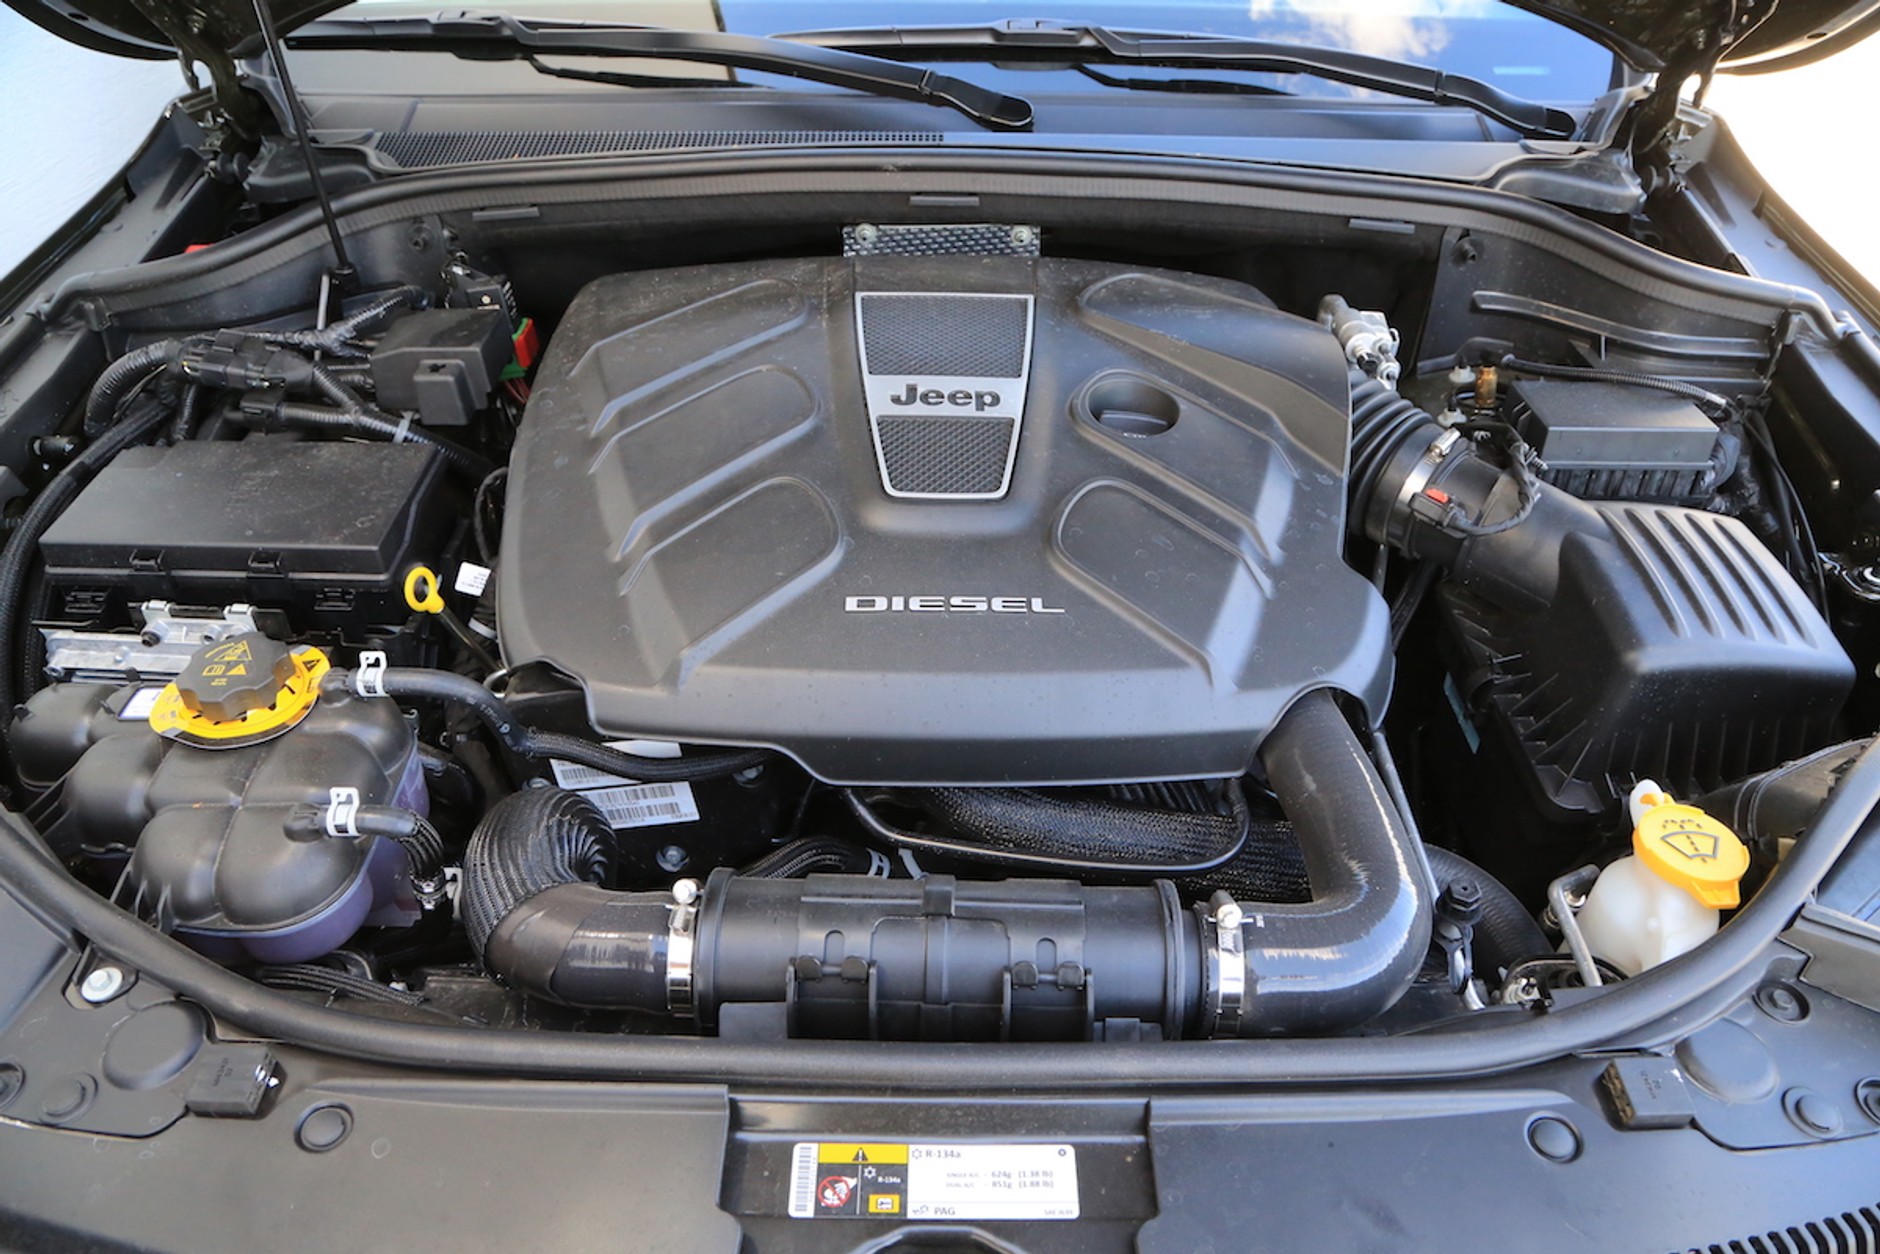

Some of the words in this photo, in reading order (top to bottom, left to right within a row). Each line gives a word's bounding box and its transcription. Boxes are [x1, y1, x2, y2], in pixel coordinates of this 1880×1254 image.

[890, 383, 1001, 411] Jeep
[844, 595, 1066, 613] DIESEL
[925, 1149, 961, 1159] R-134a
[933, 1207, 956, 1216] PAG
